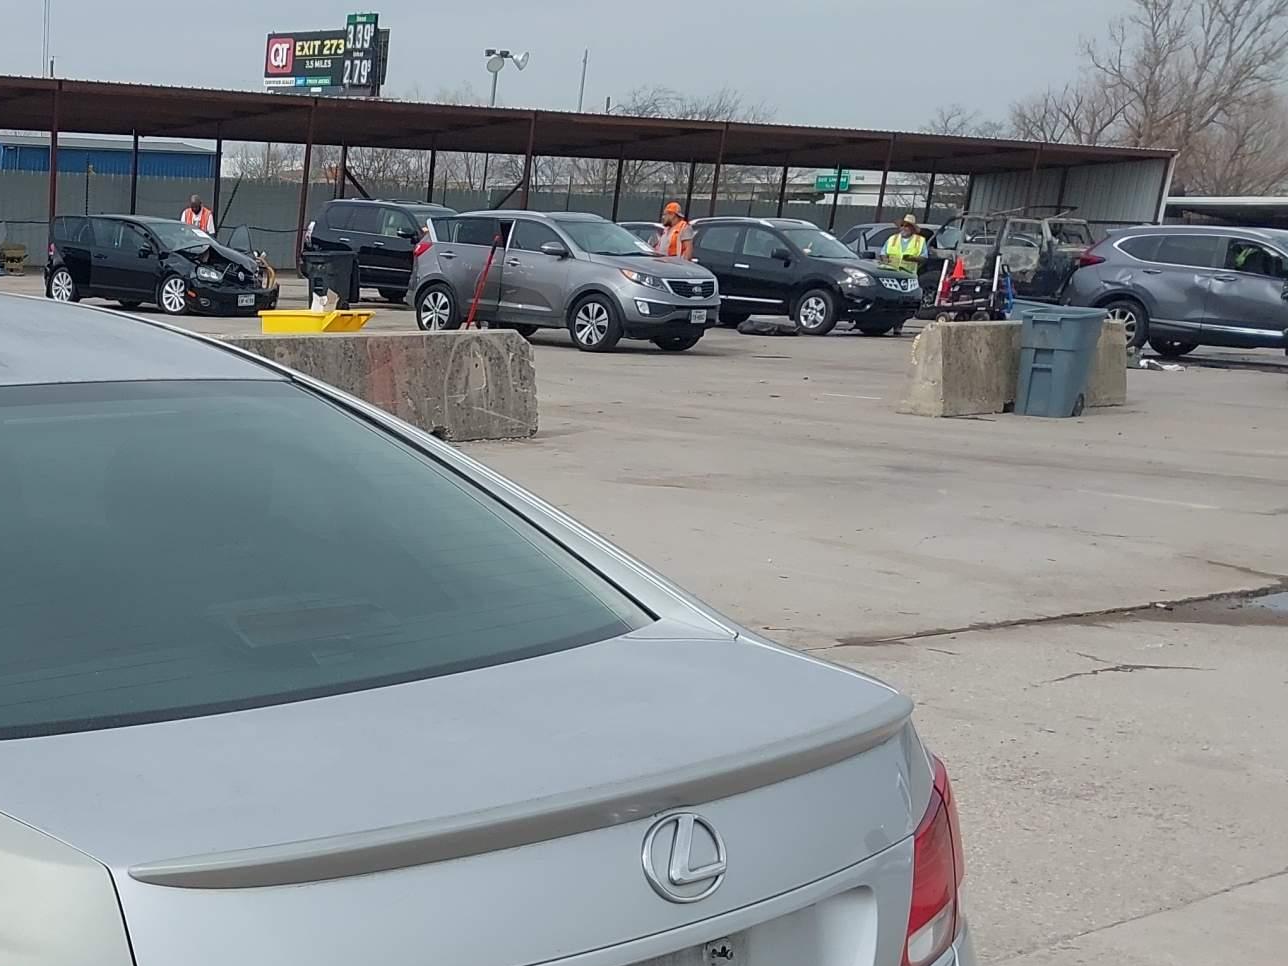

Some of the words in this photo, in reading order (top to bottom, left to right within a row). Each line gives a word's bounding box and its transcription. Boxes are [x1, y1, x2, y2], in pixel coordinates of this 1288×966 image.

[270, 43, 290, 67] QT
[295, 41, 321, 56] EXIT
[323, 38, 345, 54] 273
[315, 59, 332, 68] MILES
